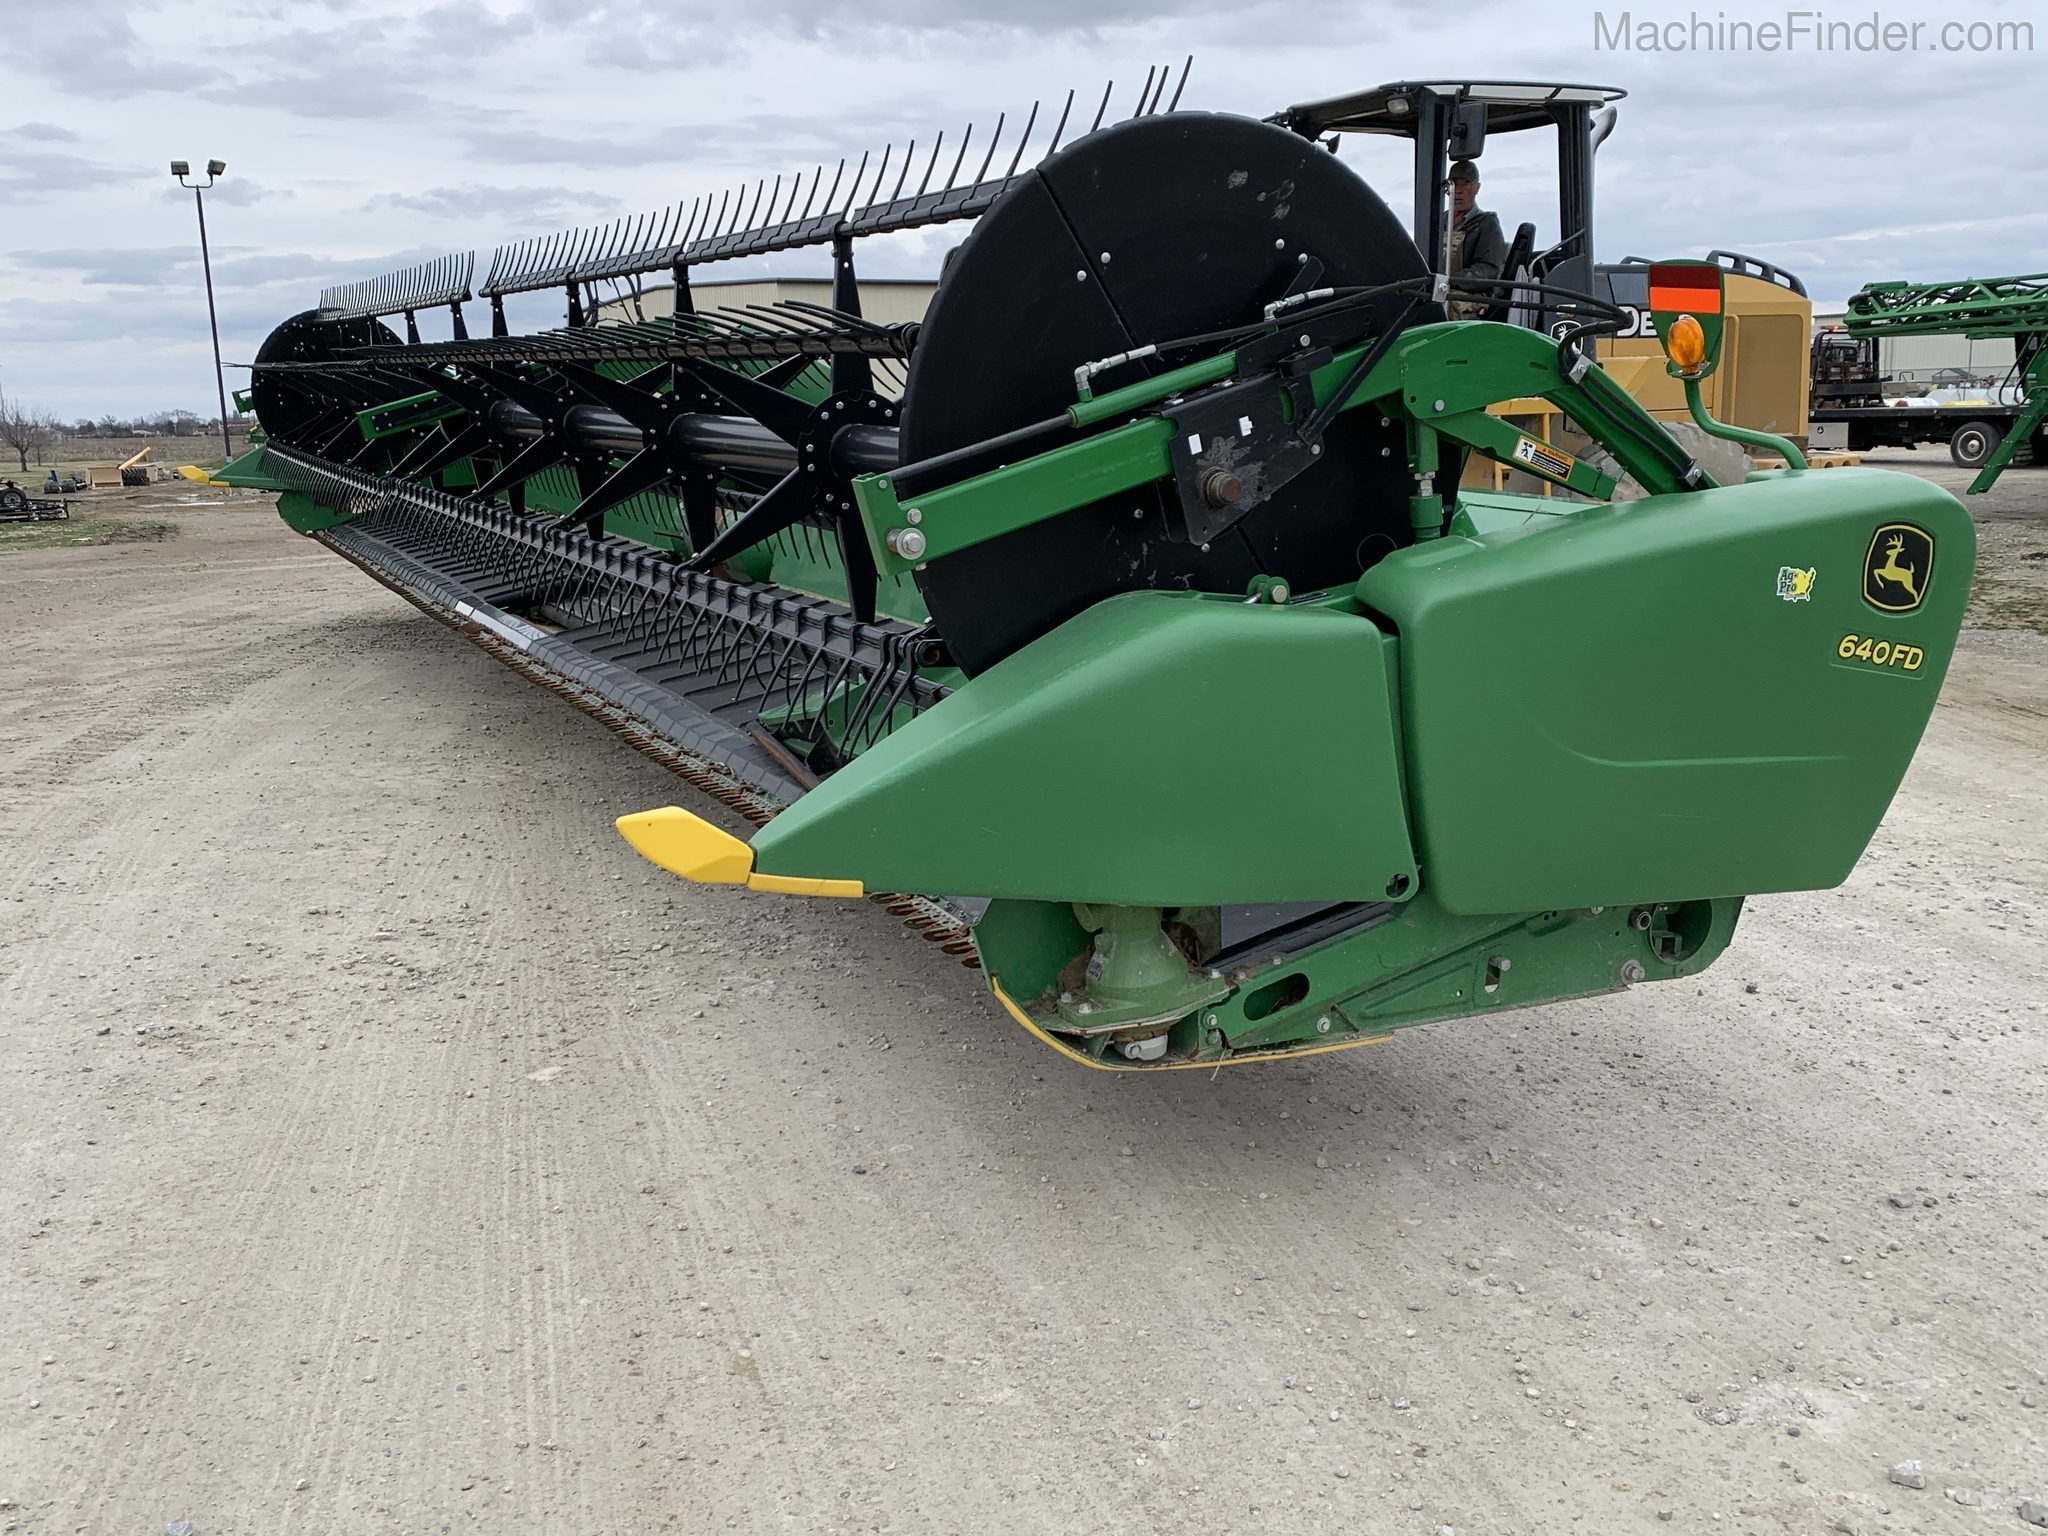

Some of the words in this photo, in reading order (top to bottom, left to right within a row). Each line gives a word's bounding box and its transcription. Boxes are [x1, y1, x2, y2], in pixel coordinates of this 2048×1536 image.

[1616, 306, 1658, 336] DE
[1779, 581, 1797, 592] Pro
[1838, 634, 1924, 670] 640FD
